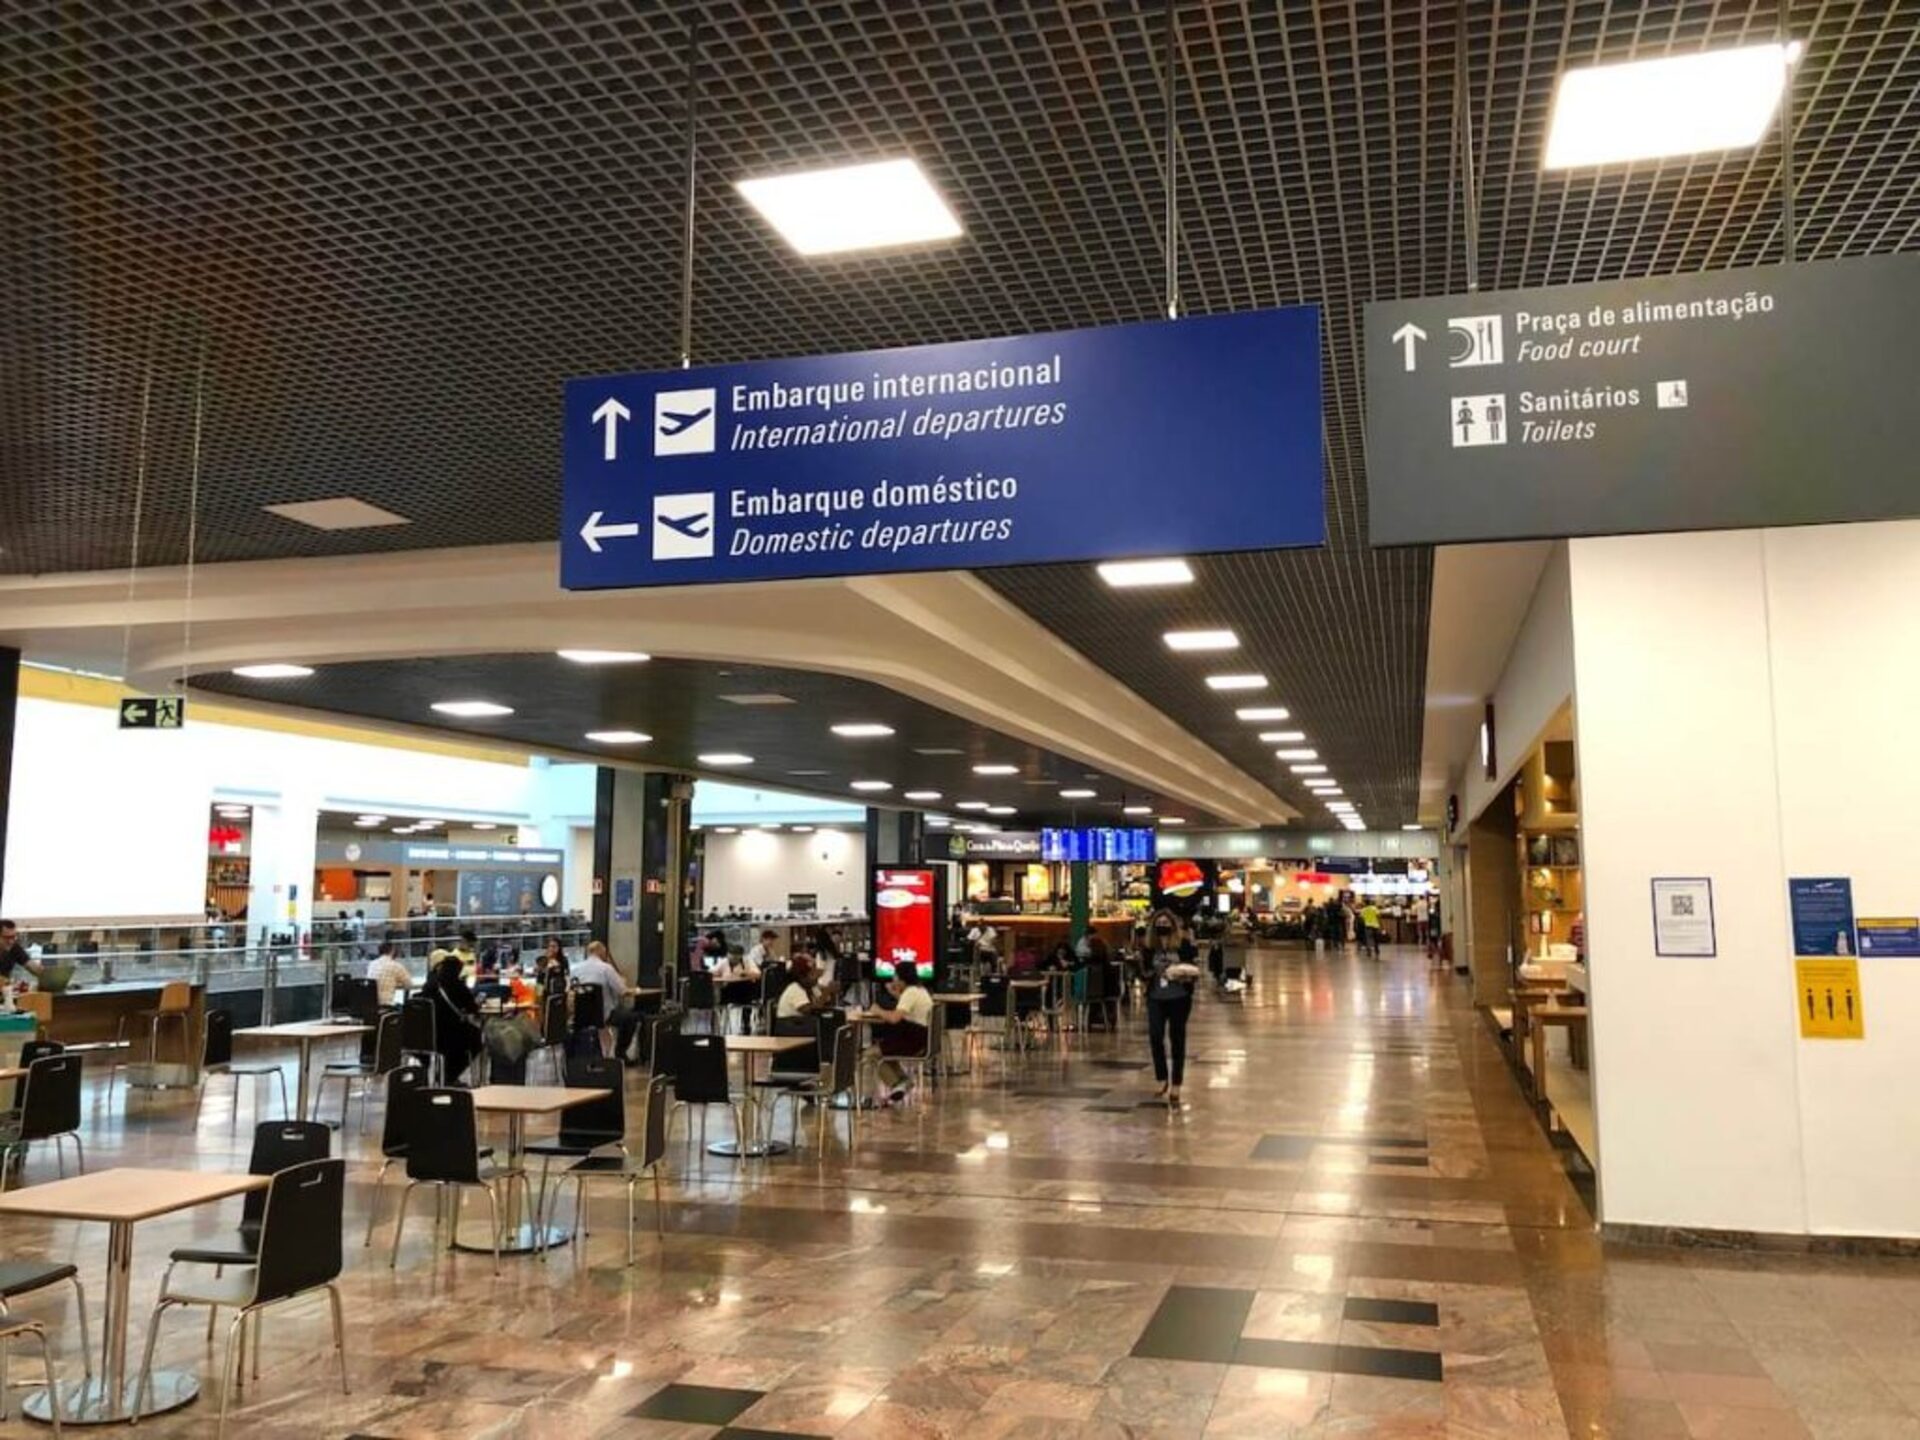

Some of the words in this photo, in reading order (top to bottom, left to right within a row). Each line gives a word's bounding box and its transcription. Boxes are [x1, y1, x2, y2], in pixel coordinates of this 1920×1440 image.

[1516, 310, 1580, 335] Praça
[1588, 304, 1616, 327] de
[1621, 291, 1775, 324] alimentação
[1517, 337, 1573, 362] Food
[1579, 334, 1641, 358] court
[732, 380, 866, 412] Embarque
[873, 354, 1062, 398] internacional
[1519, 386, 1641, 414] Sanitários
[730, 407, 907, 450] International
[912, 402, 1067, 438] departures
[1522, 420, 1597, 443] Toilets
[731, 488, 866, 518] Embarque
[872, 472, 1018, 508] doméstico
[729, 520, 853, 555] Domestic
[861, 517, 1013, 553] departures
